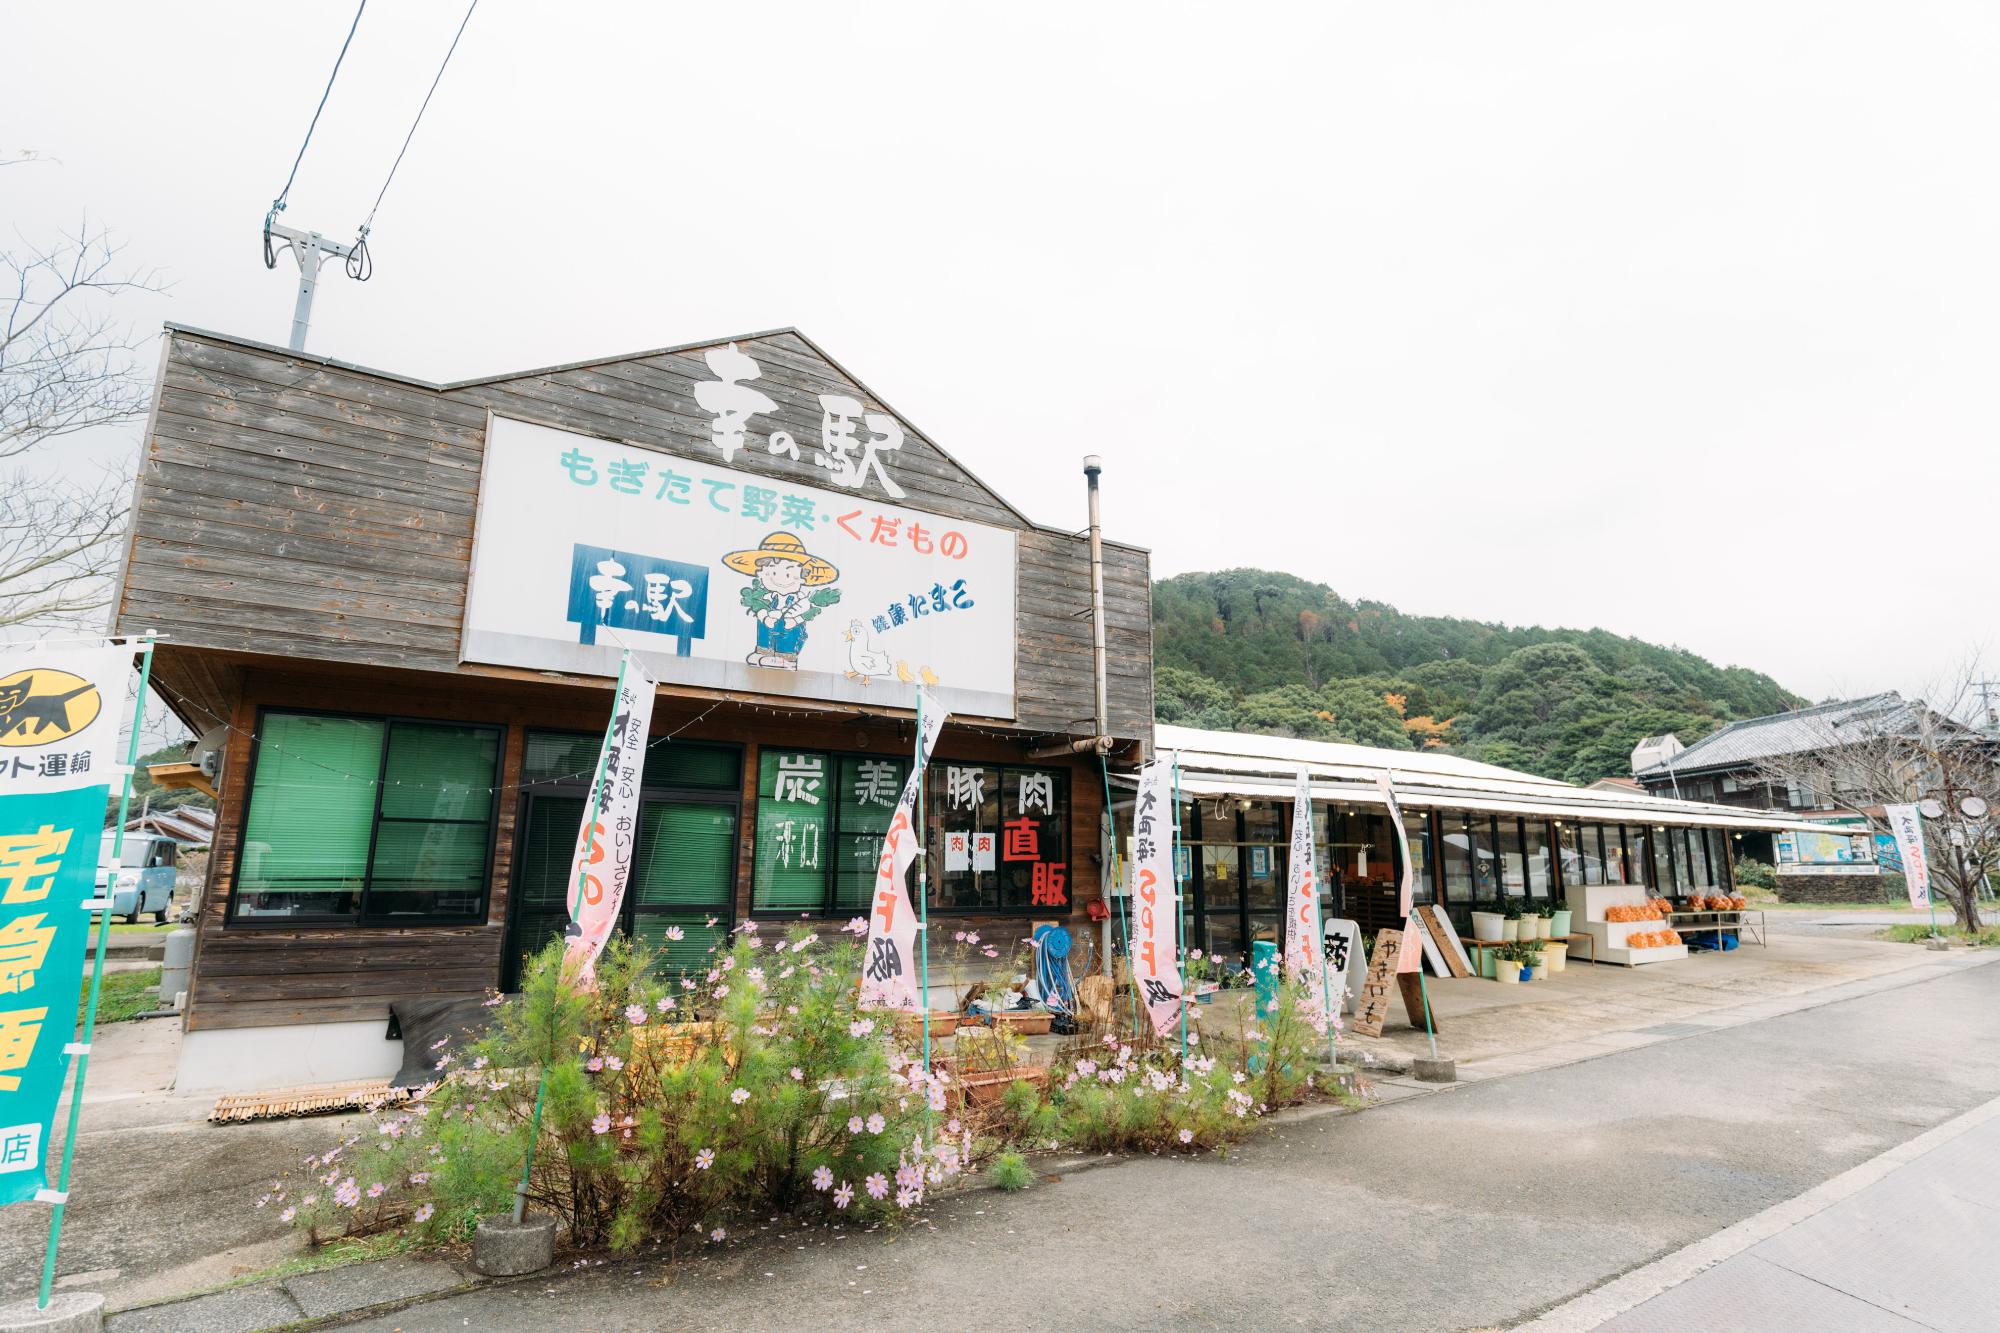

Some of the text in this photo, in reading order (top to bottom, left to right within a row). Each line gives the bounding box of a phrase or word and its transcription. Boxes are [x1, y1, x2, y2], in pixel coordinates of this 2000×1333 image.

[693, 342, 906, 498] 幸の駅
[560, 447, 969, 560] もぎたて野菜・くだもの
[588, 557, 695, 625] 幸の駅
[978, 837, 991, 852] 肉
[1002, 817, 1068, 906] 直販
[1365, 939, 1397, 1024] やきいも
